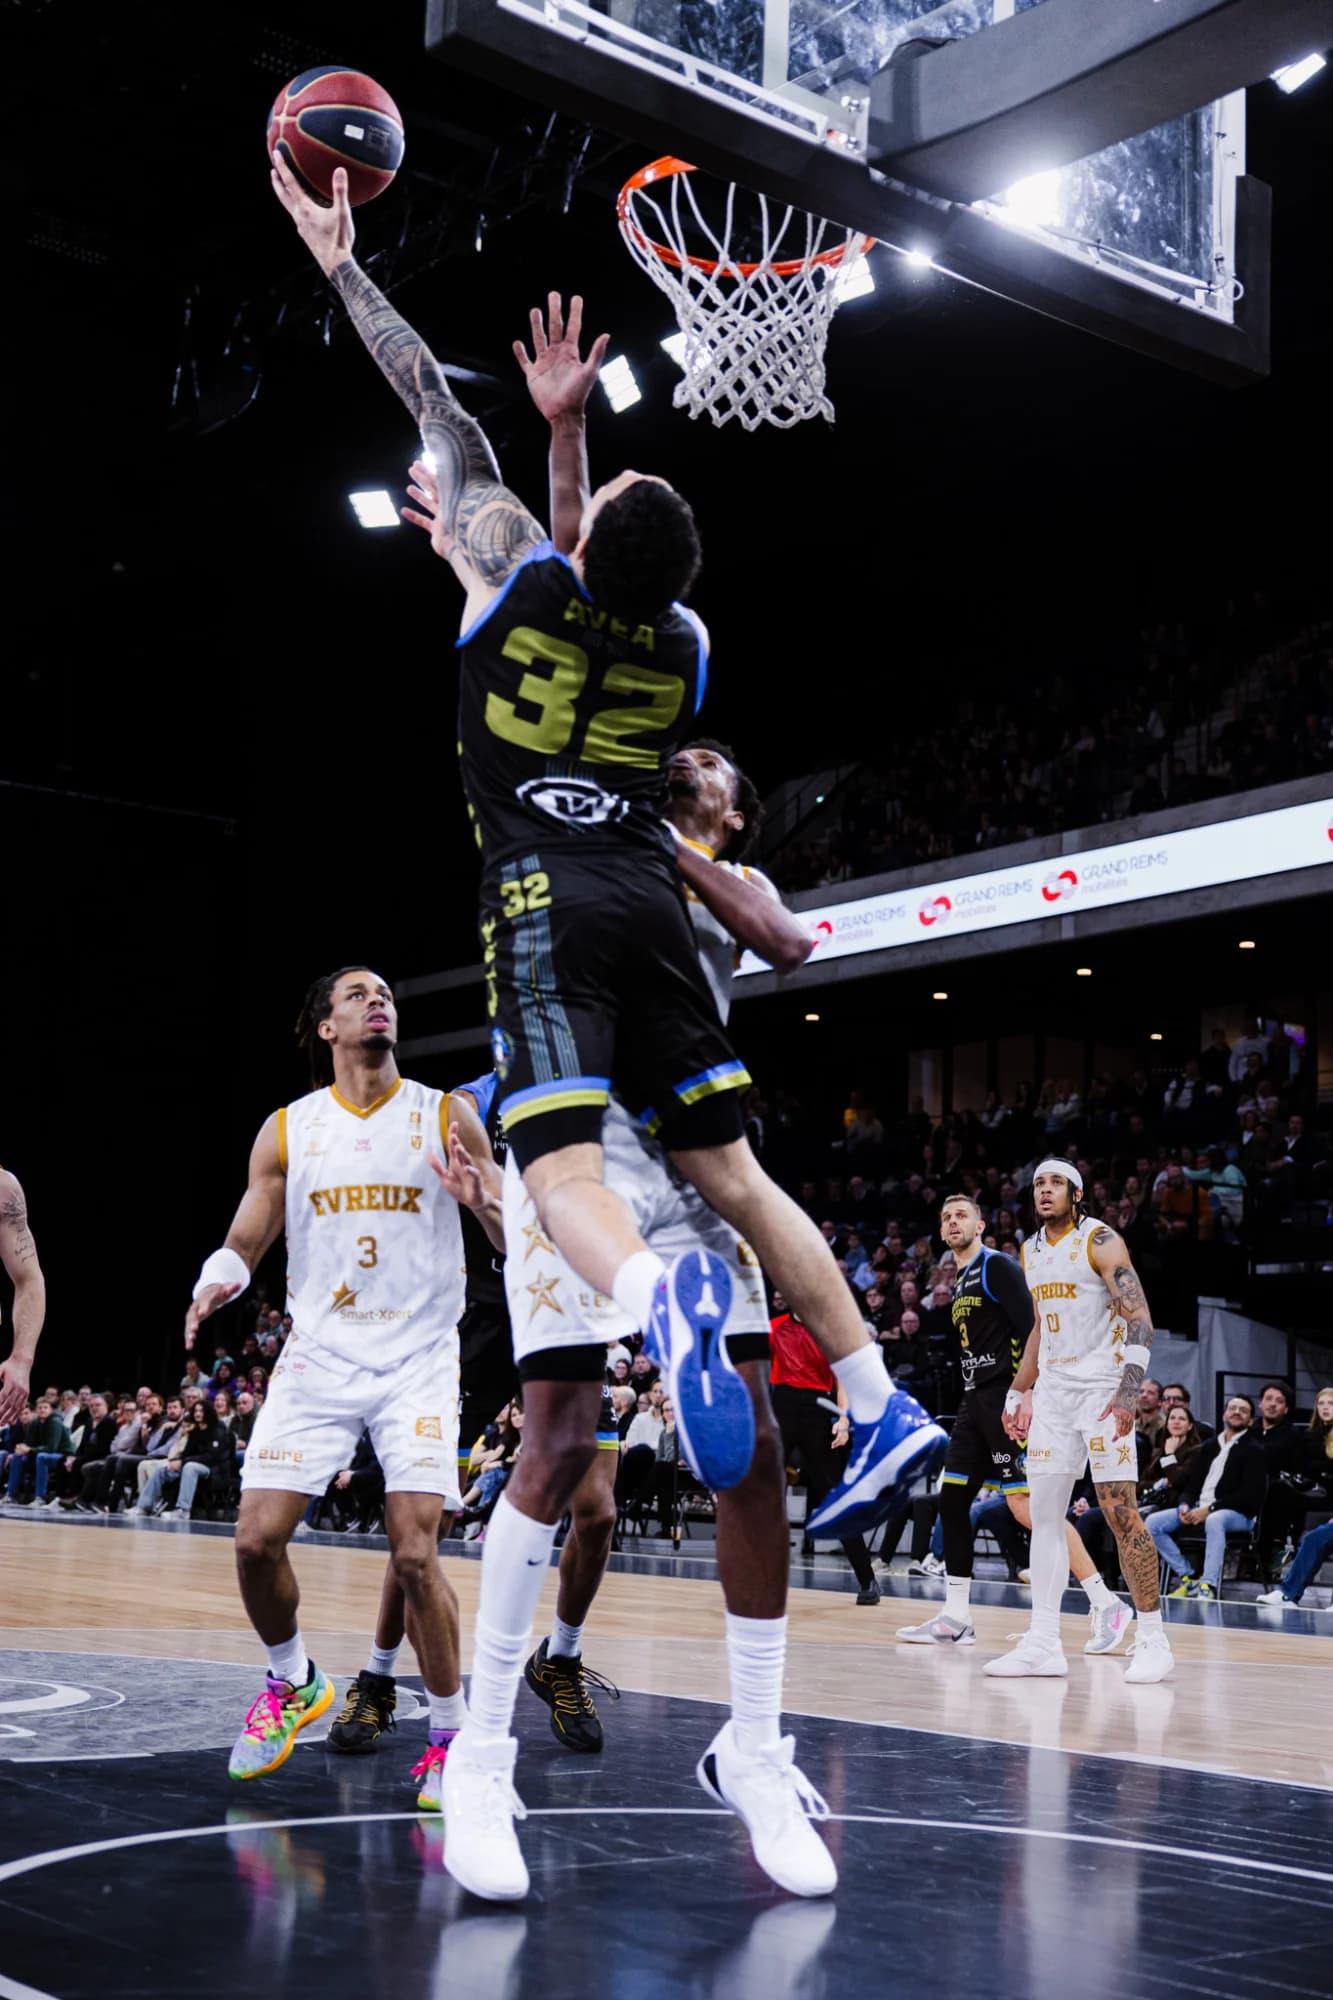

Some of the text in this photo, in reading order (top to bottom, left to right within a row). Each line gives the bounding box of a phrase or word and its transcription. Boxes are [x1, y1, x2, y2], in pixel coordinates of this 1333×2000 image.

[484, 625, 686, 770] 32
[1082, 850, 1168, 880] GRAND REIMS
[499, 871, 552, 918] 32
[954, 879, 1033, 906] GRAND REIMS
[357, 1236, 378, 1269] 3
[1030, 1282, 1077, 1300] VREUX
[959, 1322, 970, 1348] 3
[1046, 1312, 1060, 1333] 0
